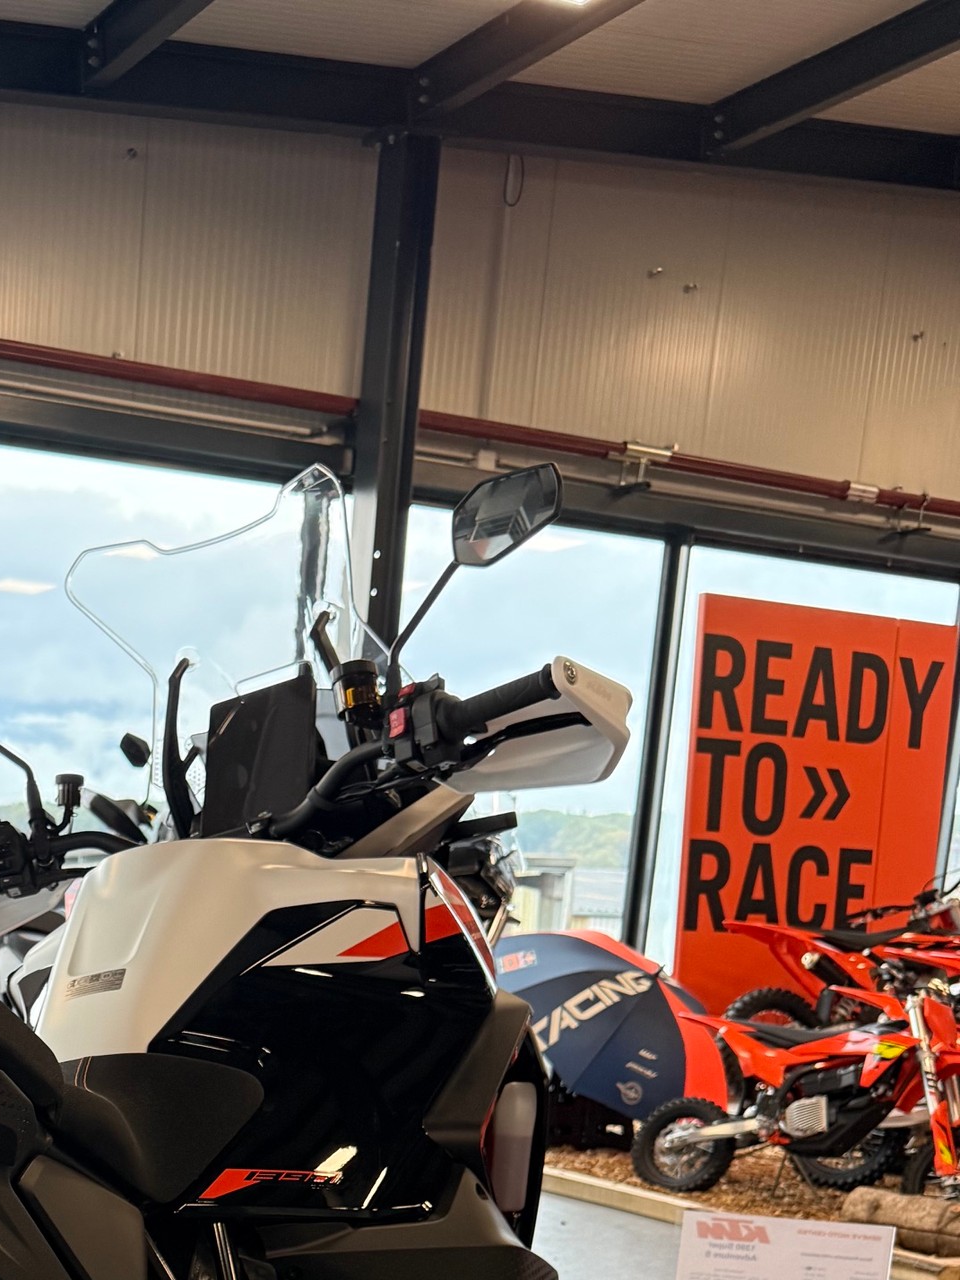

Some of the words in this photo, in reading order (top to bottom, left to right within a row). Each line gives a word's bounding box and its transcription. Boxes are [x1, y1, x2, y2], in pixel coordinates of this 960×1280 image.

[698, 632, 945, 750] READY
[695, 737, 788, 837] TO
[684, 839, 873, 933] RACE
